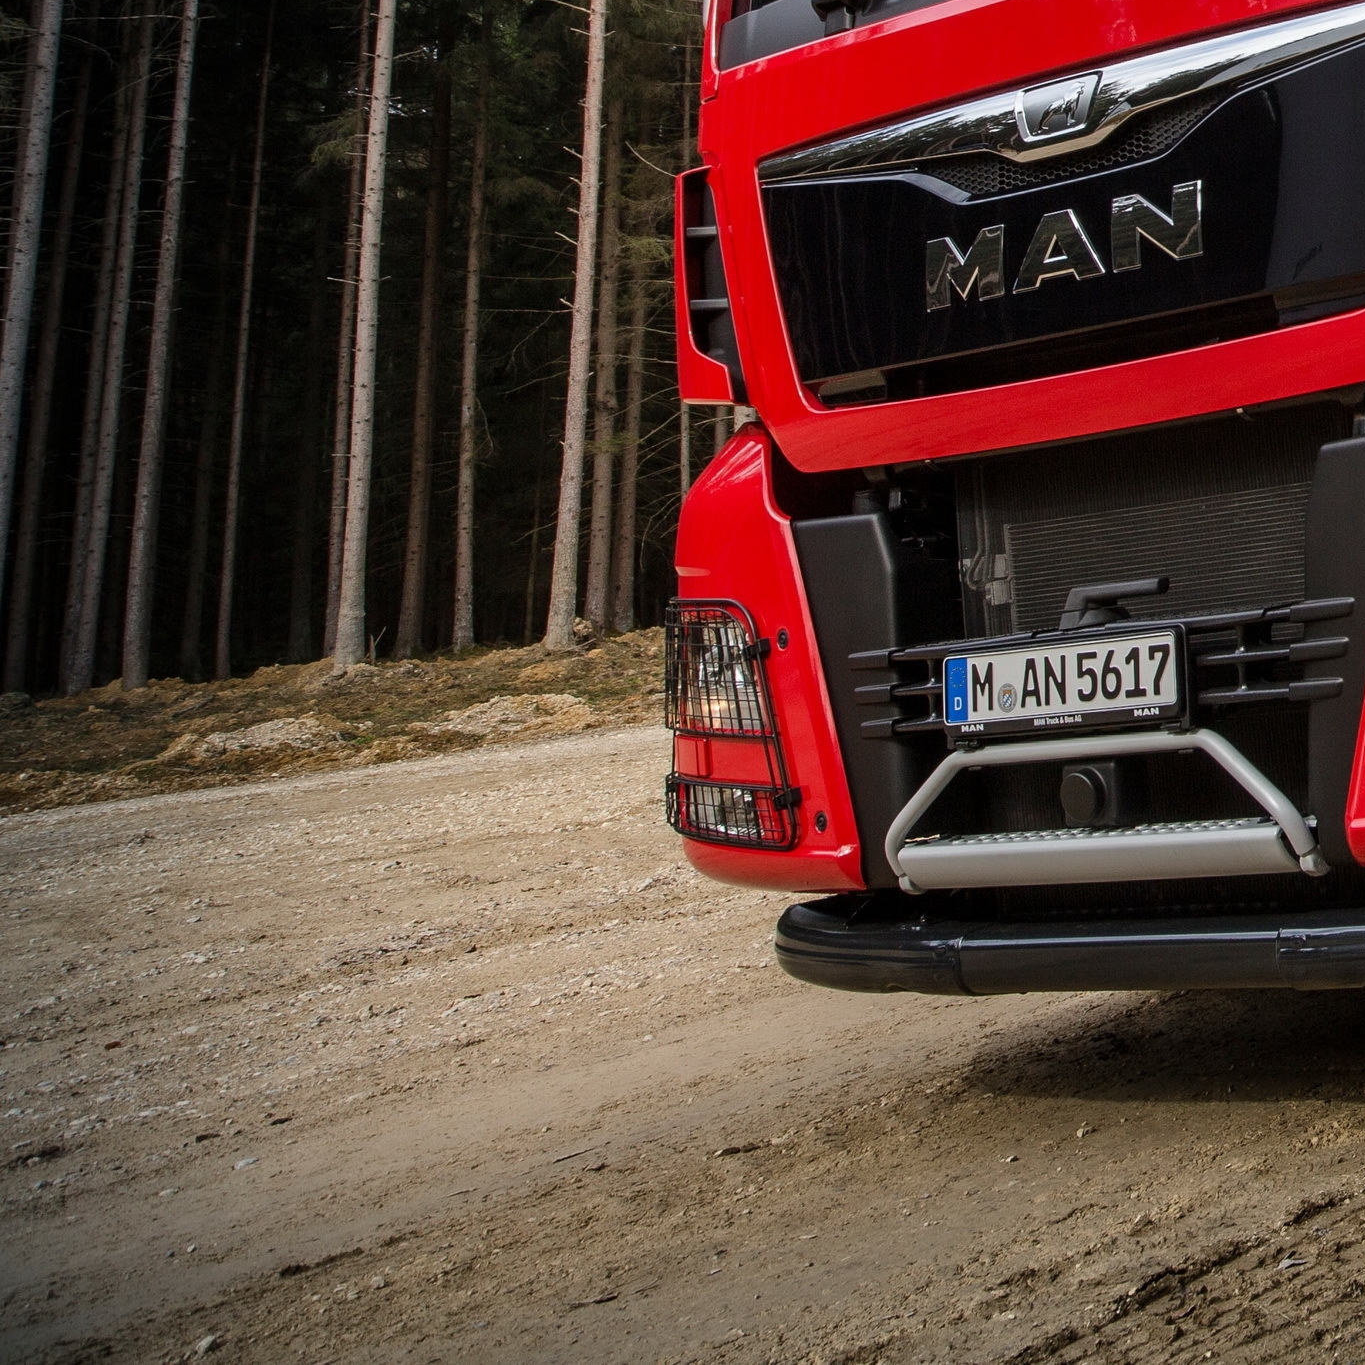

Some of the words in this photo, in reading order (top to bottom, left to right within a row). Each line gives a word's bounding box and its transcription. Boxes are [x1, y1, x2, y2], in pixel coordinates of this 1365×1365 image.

[926, 179, 1203, 313] MAN
[971, 661, 994, 713] M
[1020, 654, 1067, 709] AN
[1076, 642, 1171, 702] 5617
[953, 696, 963, 711] D
[1133, 707, 1160, 717] MAN
[1033, 718, 1046, 726] MAN
[1046, 716, 1059, 726] Truck
[1059, 716, 1064, 724] &
[1064, 715, 1074, 724] Bus
[1074, 714, 1082, 723] AG
[960, 723, 985, 733] MAN
